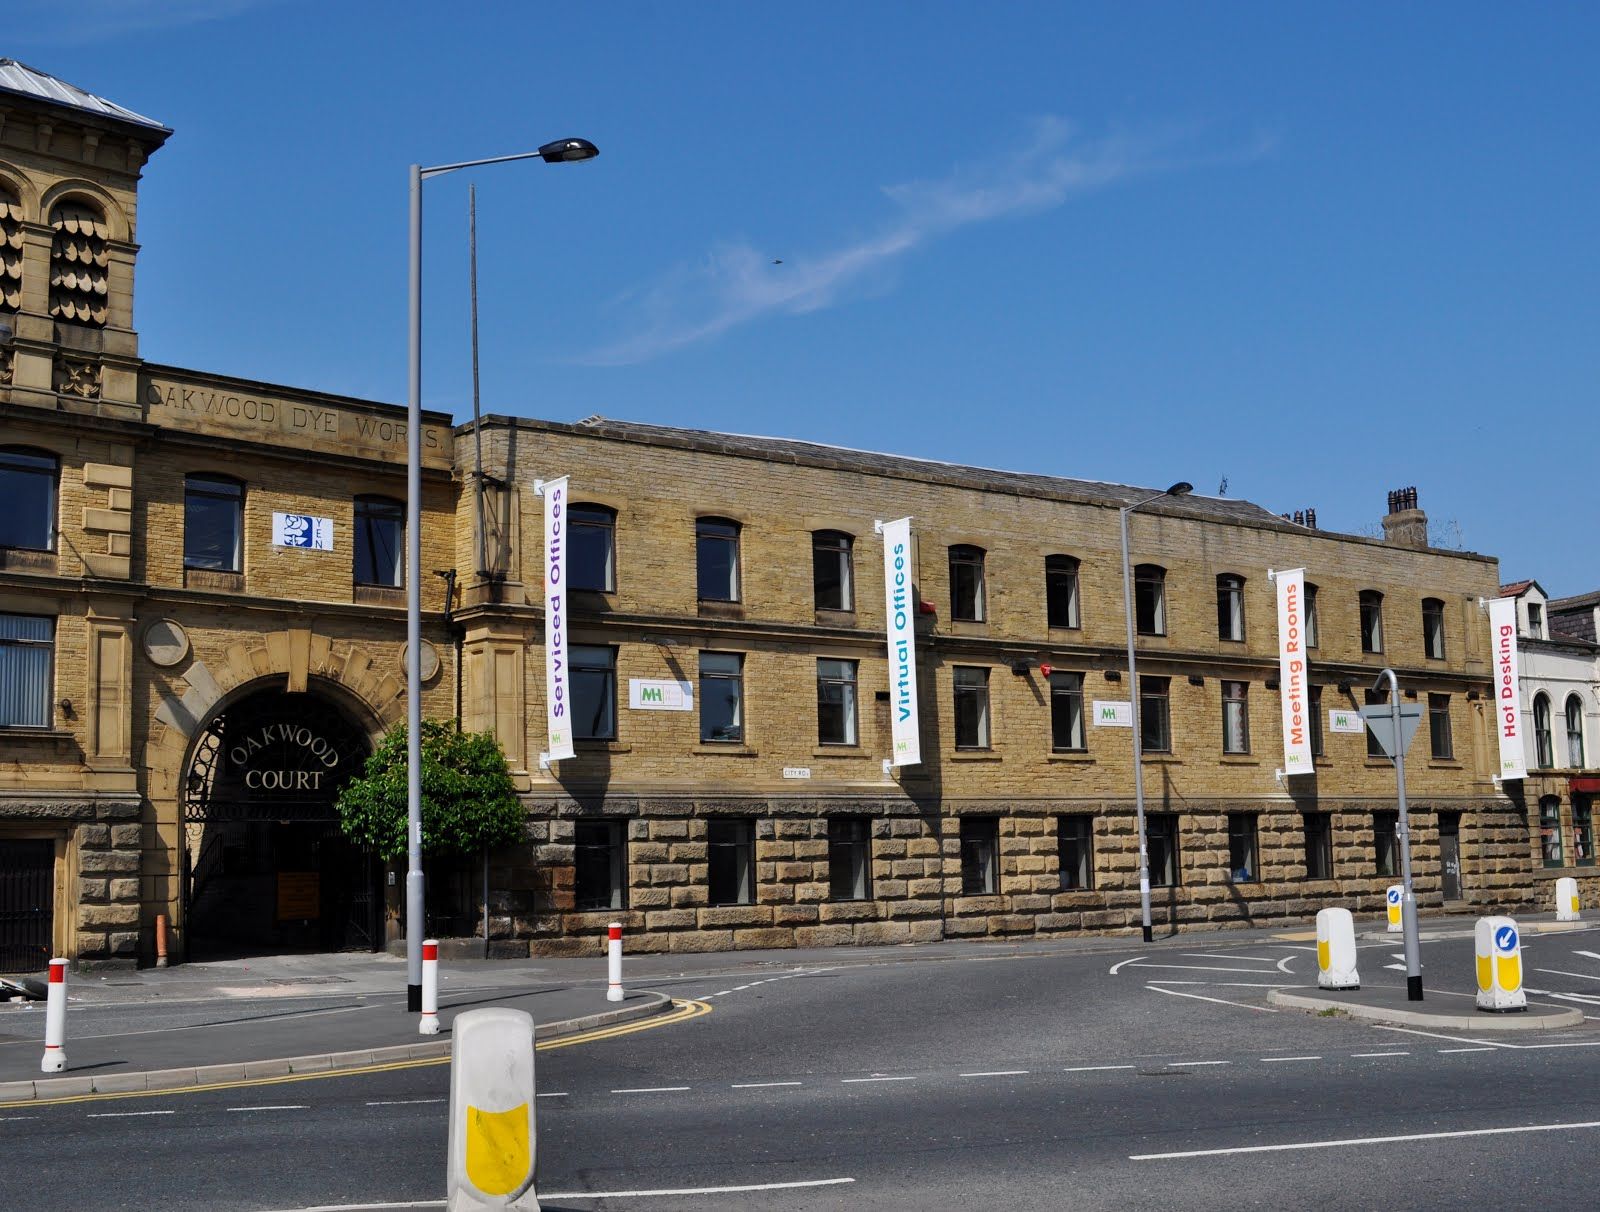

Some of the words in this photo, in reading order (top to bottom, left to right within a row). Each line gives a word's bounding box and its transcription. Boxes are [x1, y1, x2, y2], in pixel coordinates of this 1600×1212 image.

[147, 384, 275, 423] OAKWOOD
[292, 407, 337, 433] DYE
[355, 417, 443, 449] WORS.
[550, 489, 561, 584] Offices
[894, 543, 906, 630] Offices
[1287, 584, 1298, 653] Rooms
[551, 595, 563, 717] Serviced
[896, 639, 911, 722] Virtual
[1499, 625, 1513, 699] Desking
[1288, 660, 1303, 745] Meeting
[1503, 706, 1516, 737] Hot
[230, 723, 339, 768] OAKWOOD
[245, 769, 324, 790] COURT
